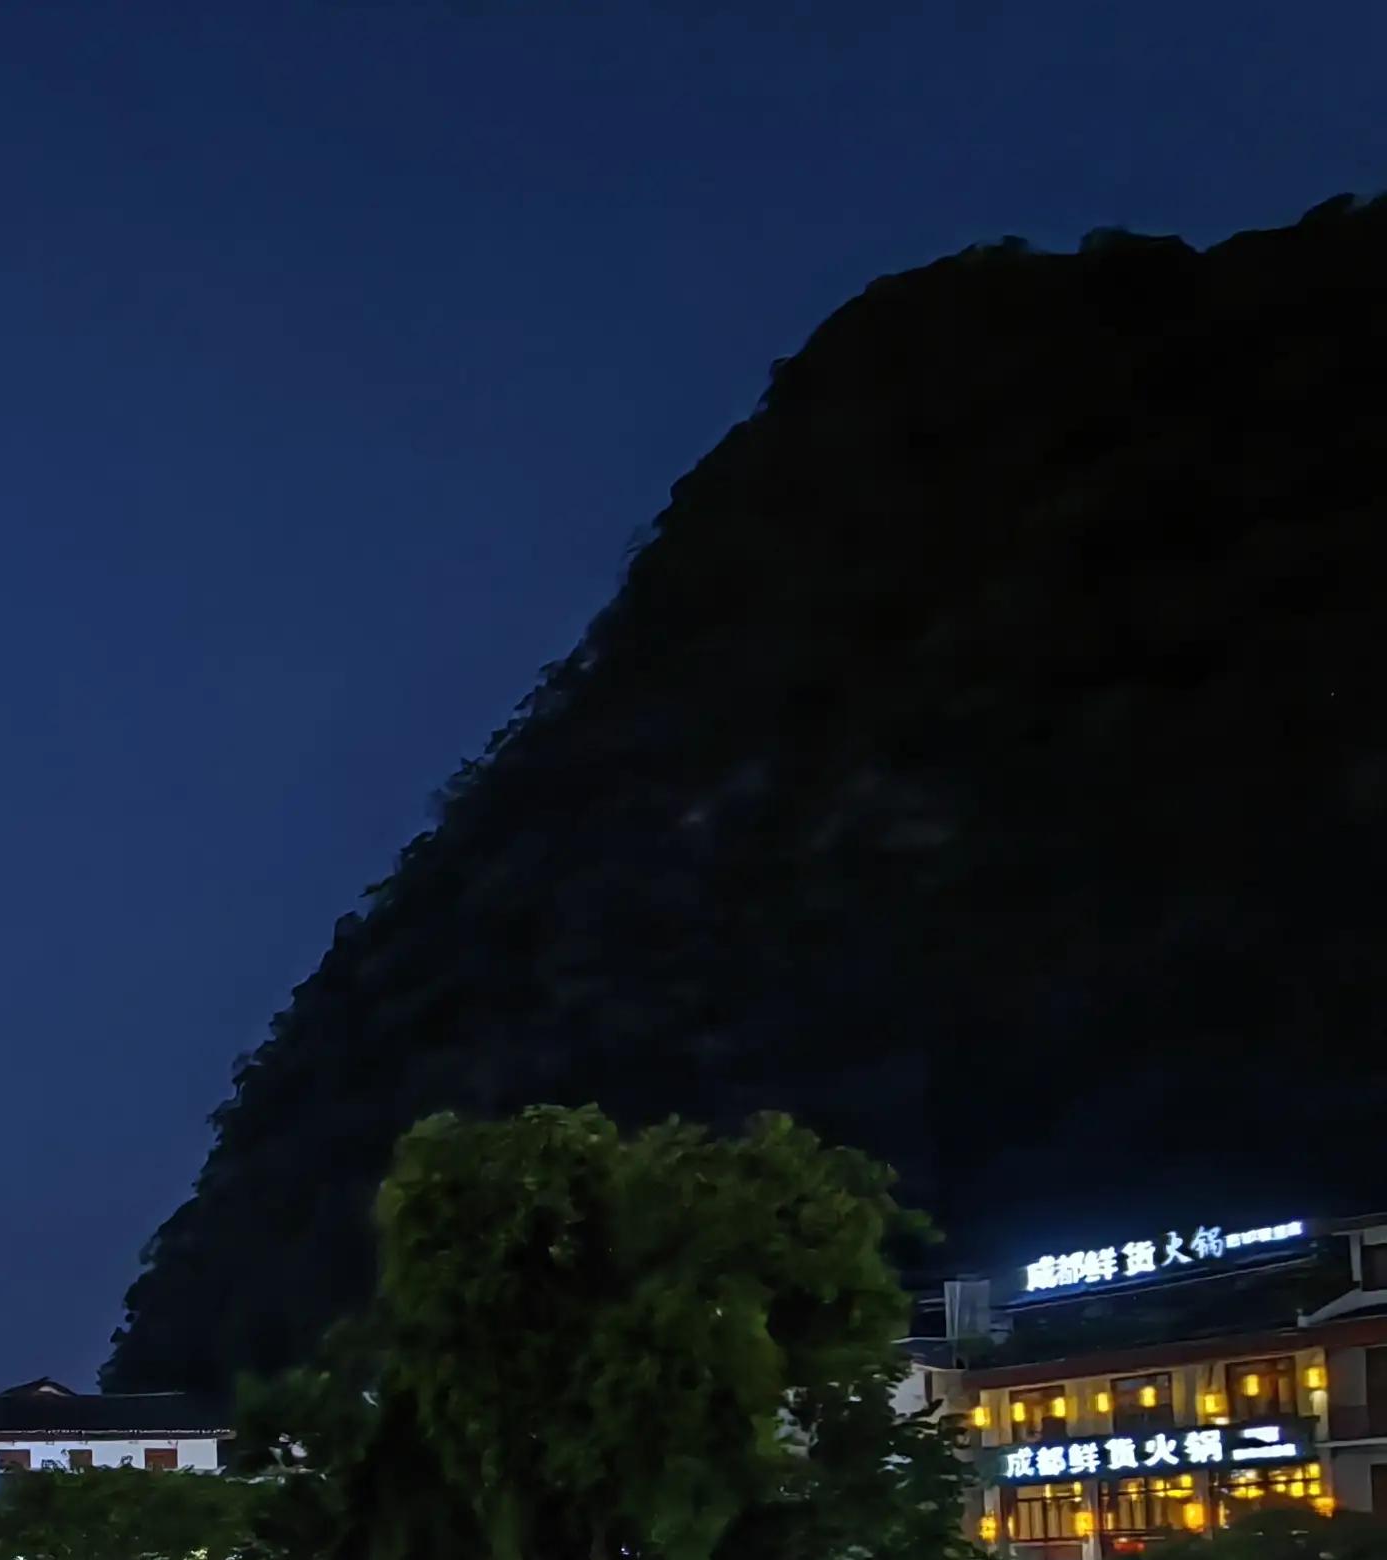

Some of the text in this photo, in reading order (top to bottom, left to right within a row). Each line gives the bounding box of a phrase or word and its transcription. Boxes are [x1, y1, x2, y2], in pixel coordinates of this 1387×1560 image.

[1006, 1430, 1224, 1479] 成都鲜货火锅
